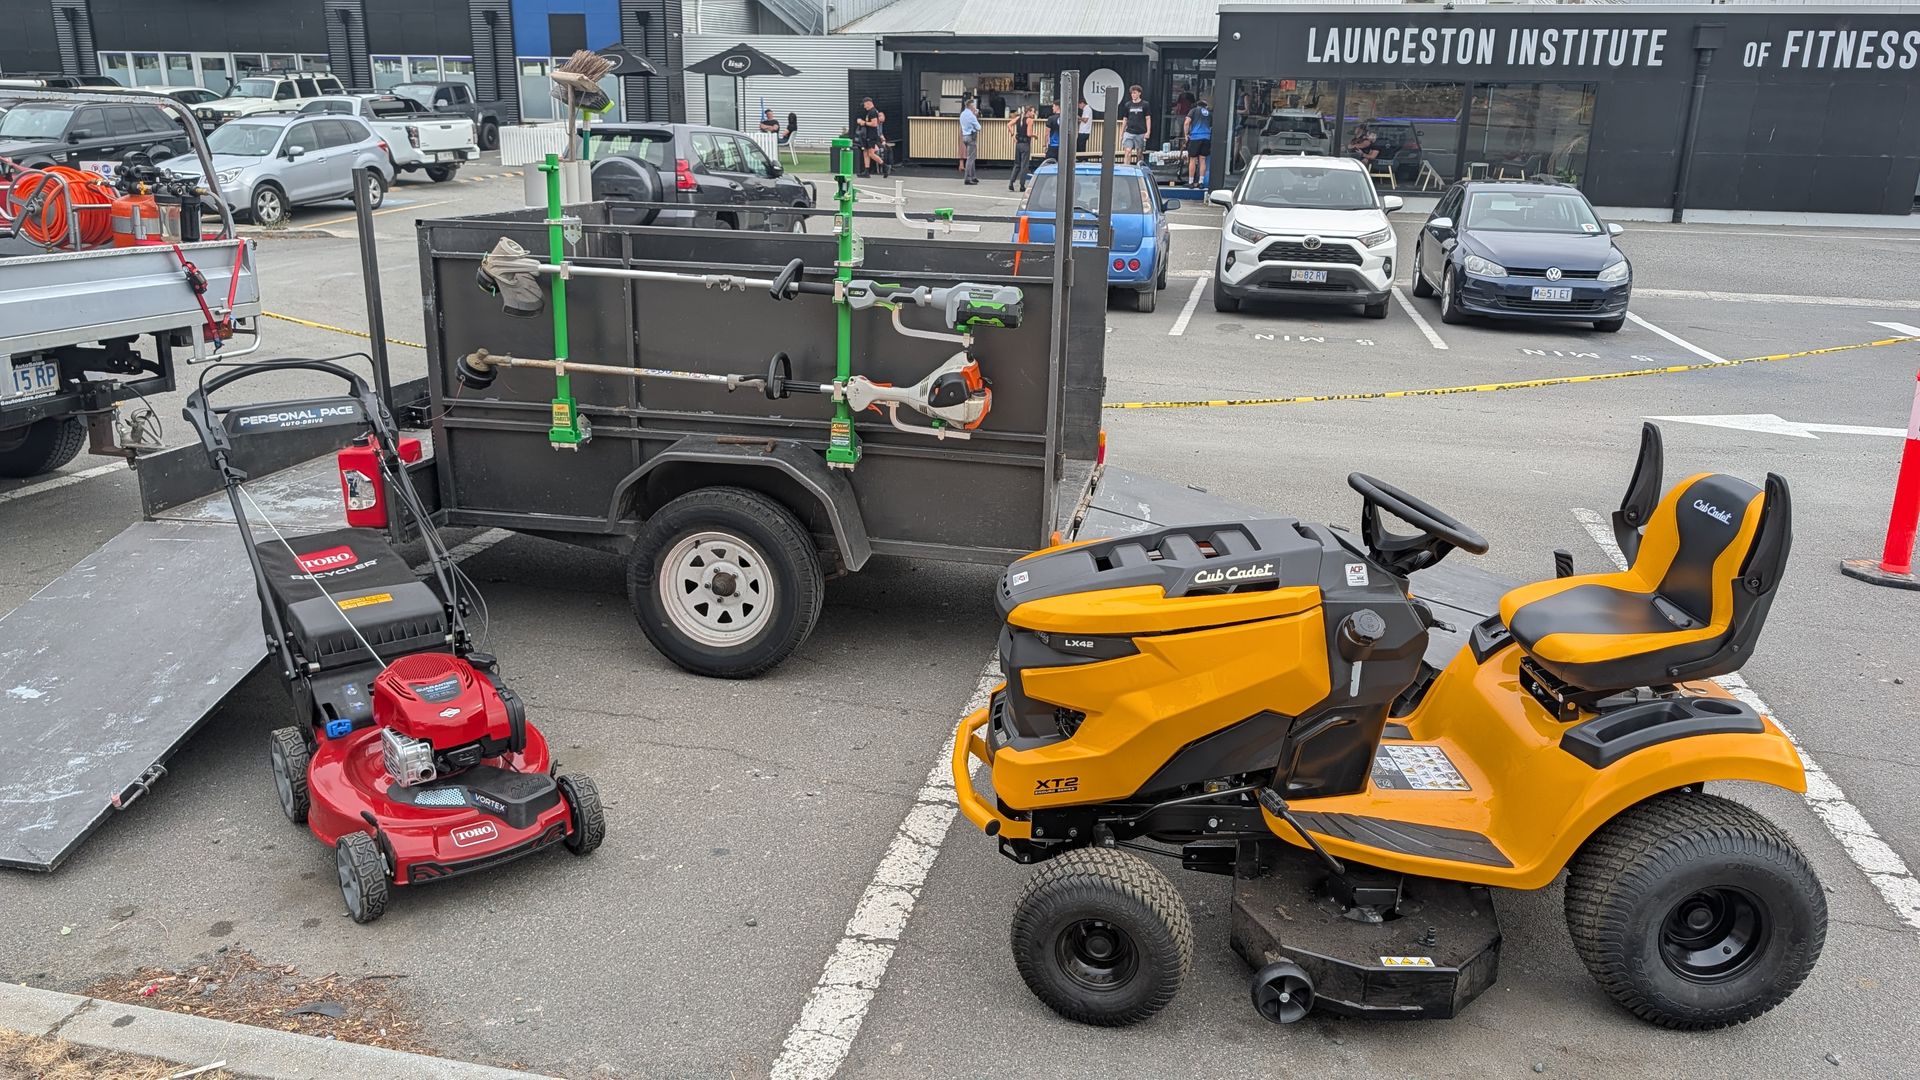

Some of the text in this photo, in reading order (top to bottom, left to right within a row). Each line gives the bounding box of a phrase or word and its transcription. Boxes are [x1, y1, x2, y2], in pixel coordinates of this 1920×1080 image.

[1307, 27, 1920, 70] LAUNCESTON INSTITUTE OF FITNESS
[1091, 80, 1112, 94] lis
[12, 364, 56, 392] 15 RP
[239, 405, 354, 427] PERSONAL PACE
[280, 417, 324, 428] AUTO-DRIVE
[1693, 499, 1732, 525] Cub Cadet
[289, 558, 378, 580] RECYCLER
[1194, 573, 1225, 584] Cub
[1064, 639, 1094, 648] LX42
[415, 679, 458, 693] GUARANTEED
[1035, 776, 1079, 790] XT2
[474, 793, 506, 812] VORTEX
